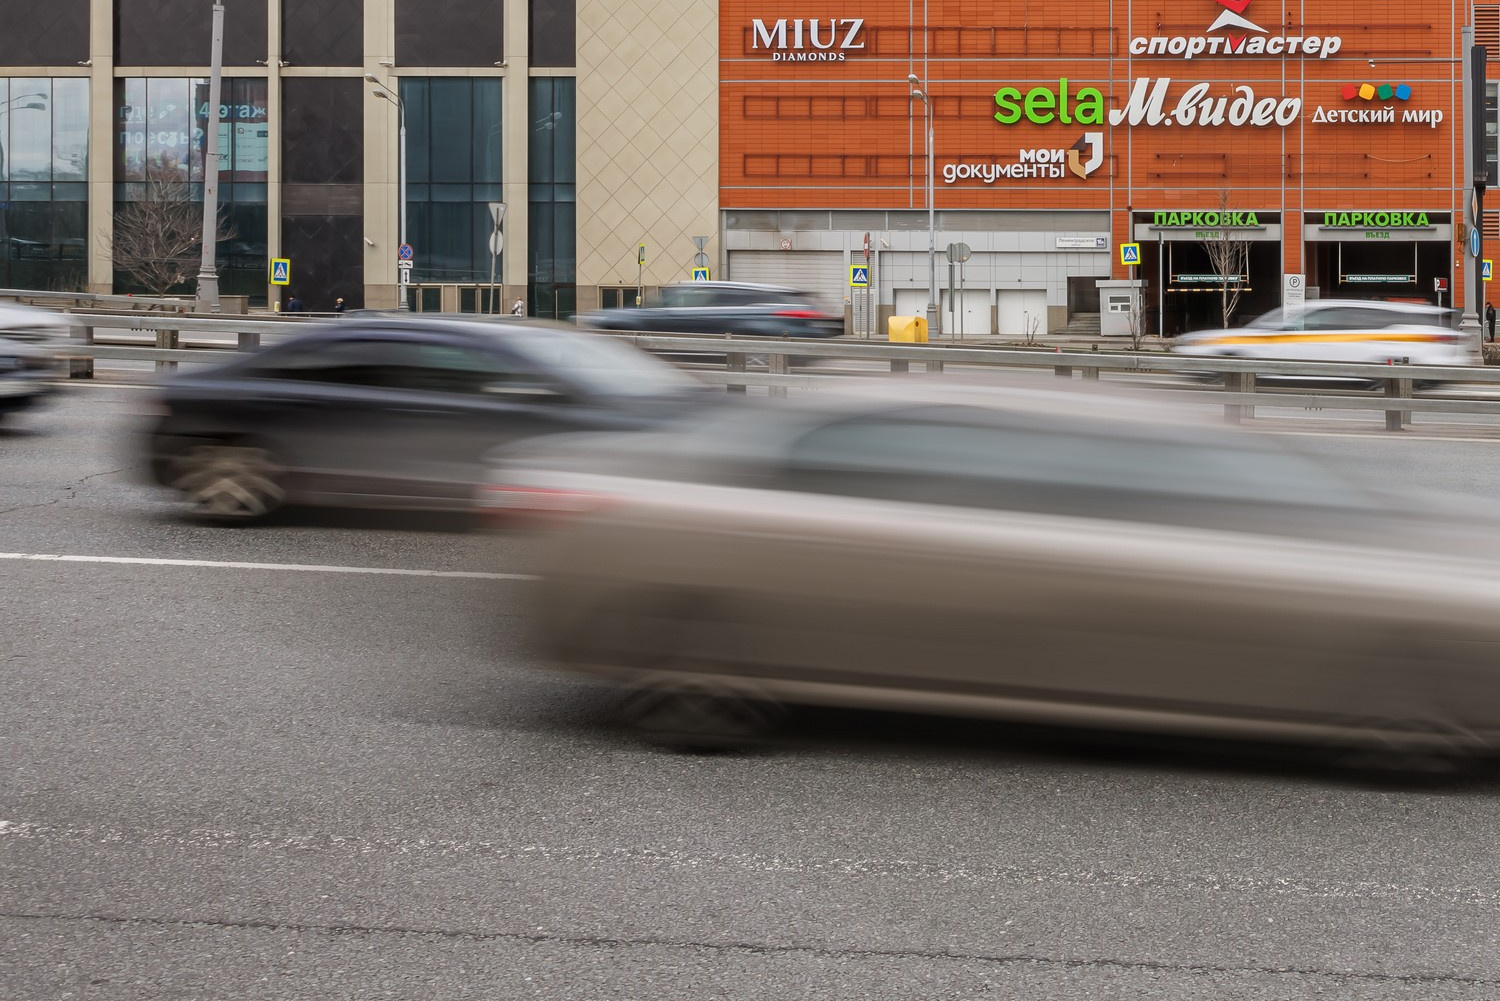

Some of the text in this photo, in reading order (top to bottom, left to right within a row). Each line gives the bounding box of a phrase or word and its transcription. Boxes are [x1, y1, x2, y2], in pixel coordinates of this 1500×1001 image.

[752, 18, 865, 49] MIUZ
[772, 52, 845, 61] DIAMONDS
[993, 78, 1104, 125] sela
[1108, 77, 1302, 127] М.видео
[1312, 105, 1444, 129] Детский мир
[1154, 211, 1259, 227] ПАРКОВКА
[1324, 212, 1429, 227] ПАРКОВКА
[1195, 231, 1220, 239] ВЪЕЗД
[1365, 231, 1390, 239] ВЪЕЗД
